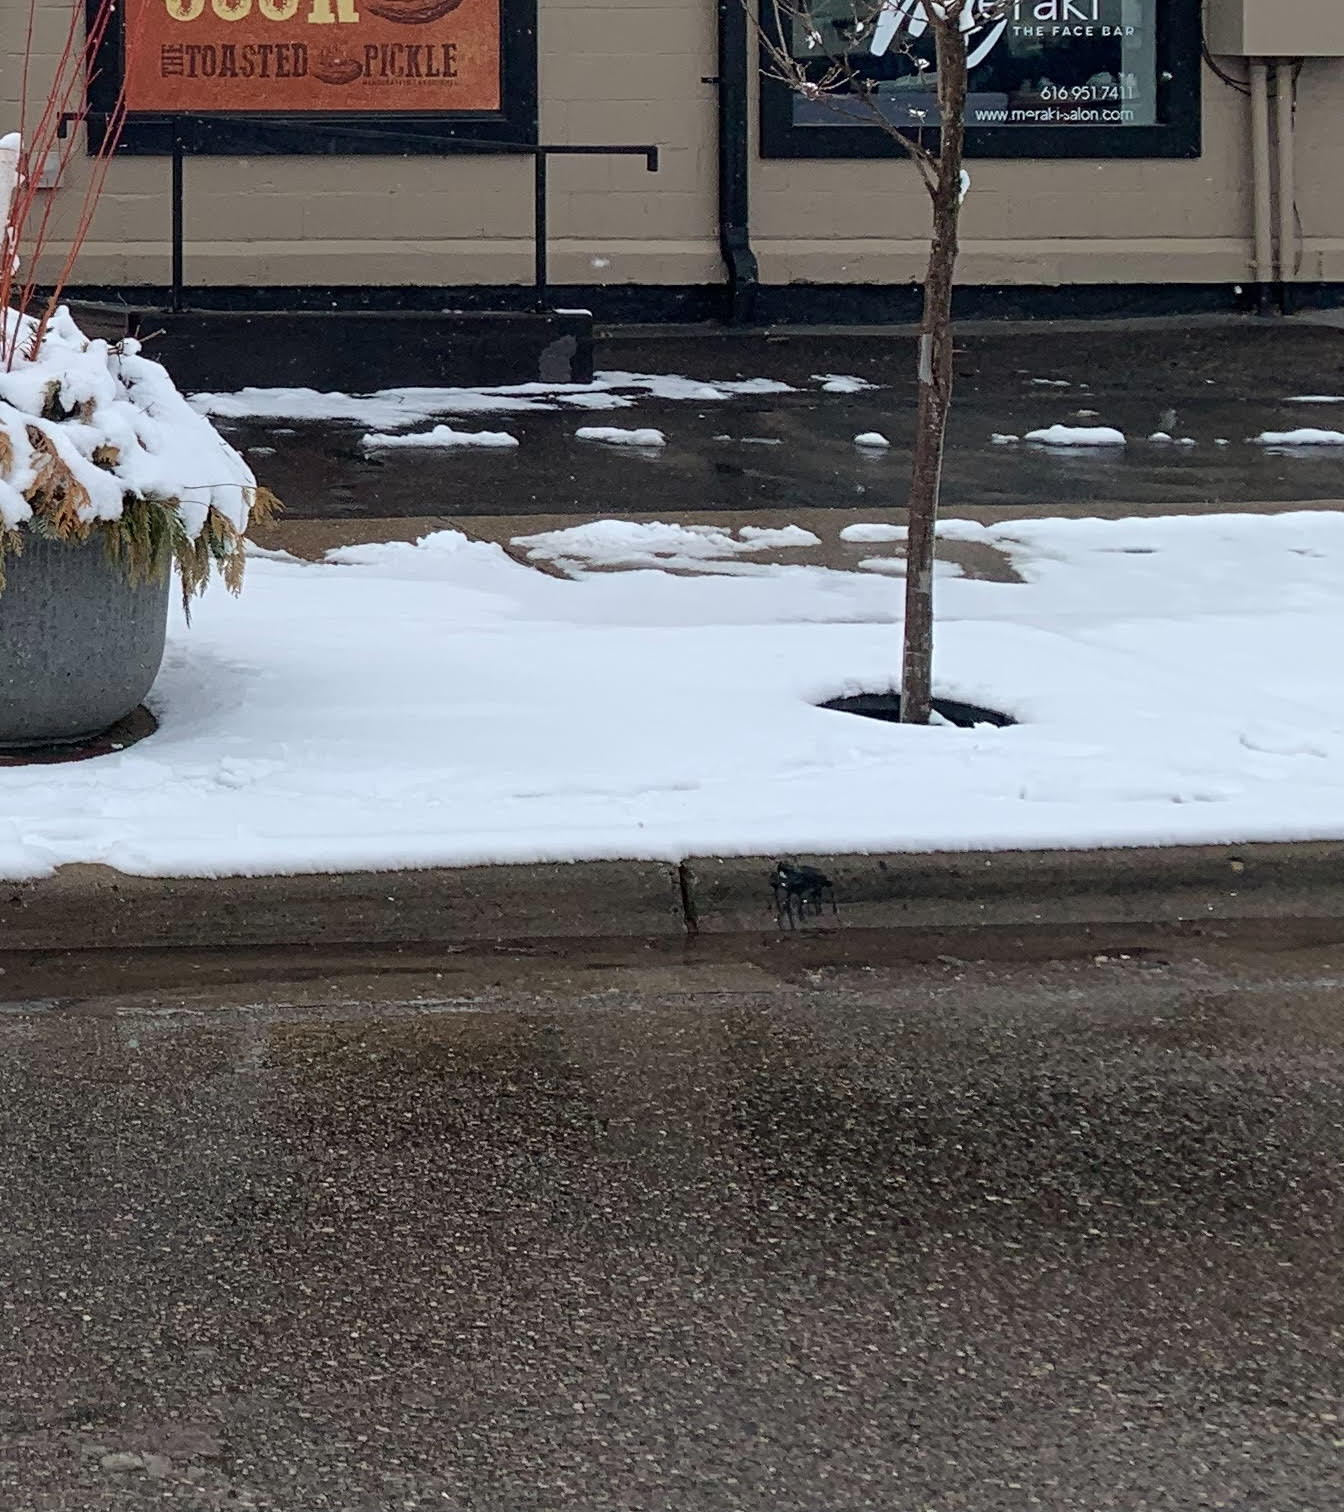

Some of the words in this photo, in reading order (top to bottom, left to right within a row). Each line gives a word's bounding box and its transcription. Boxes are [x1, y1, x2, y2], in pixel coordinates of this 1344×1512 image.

[1013, 26, 1044, 36] THE
[1052, 26, 1094, 36] FACE
[1102, 26, 1135, 36] BAR
[162, 44, 184, 77] THE
[185, 41, 309, 78] TOASTED
[363, 43, 459, 78] PICKLE
